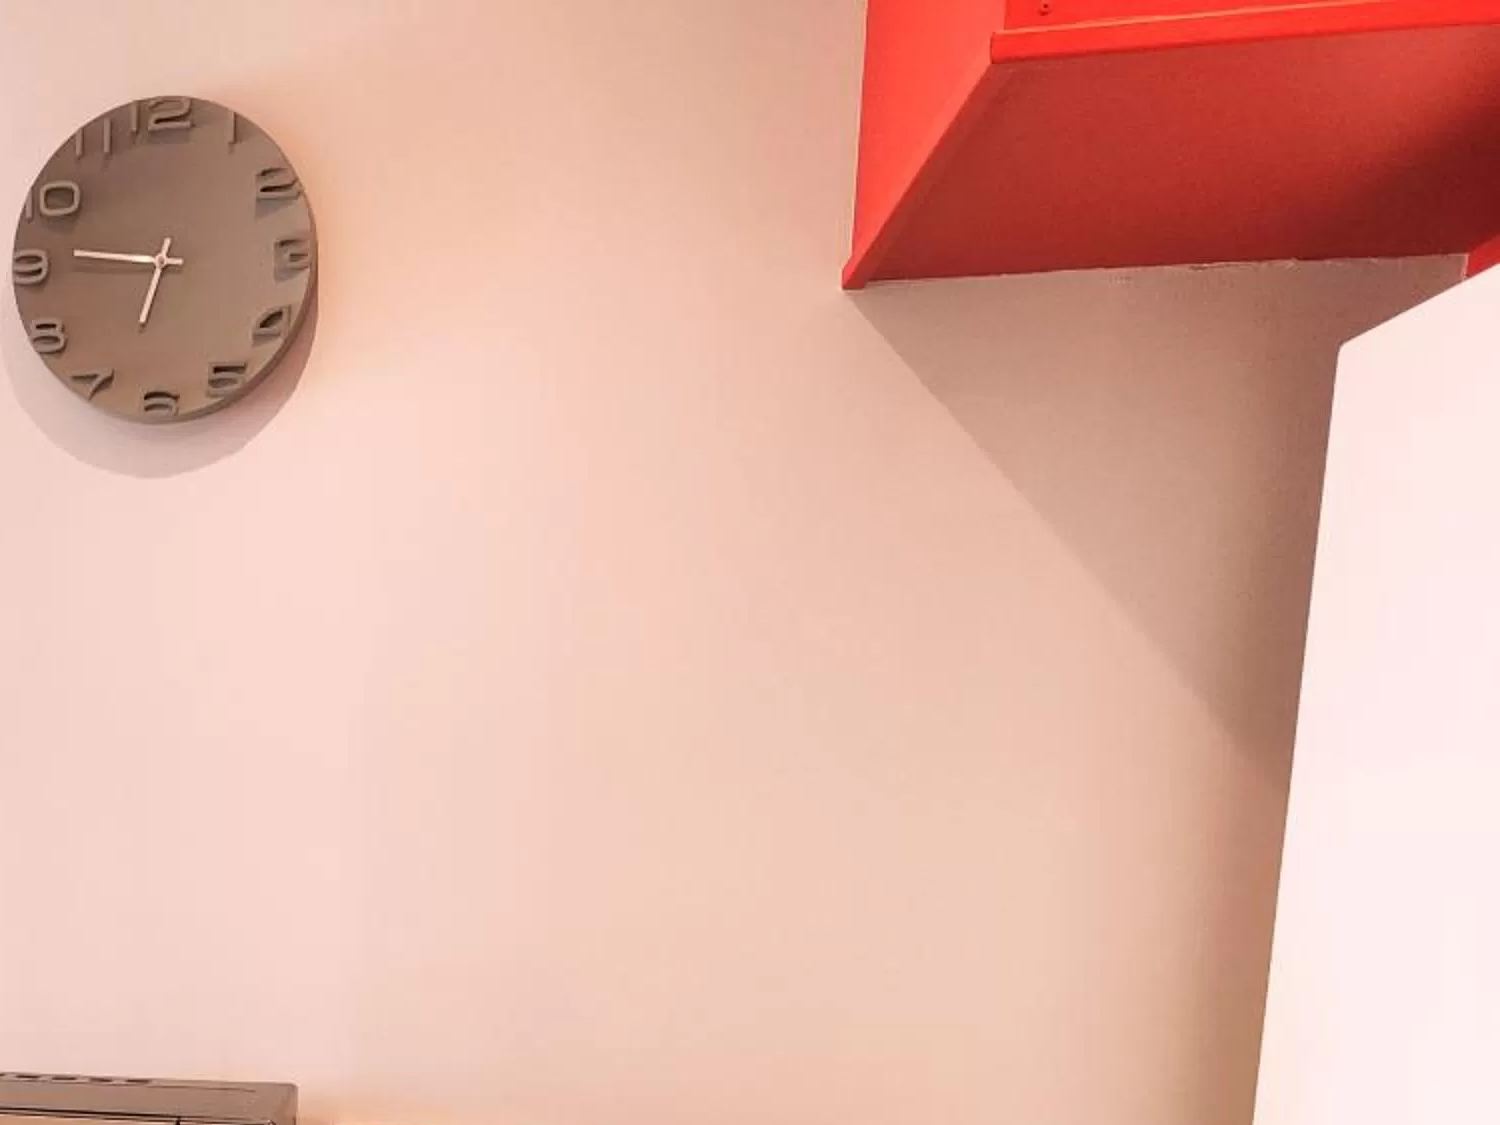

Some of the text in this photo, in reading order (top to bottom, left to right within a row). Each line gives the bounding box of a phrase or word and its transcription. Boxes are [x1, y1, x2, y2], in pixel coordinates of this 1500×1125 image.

[131, 98, 193, 132] 12
[24, 179, 81, 221] 10
[12, 249, 49, 286] 9
[31, 319, 67, 354] 8
[68, 367, 115, 402] 7
[206, 361, 248, 397] 5
